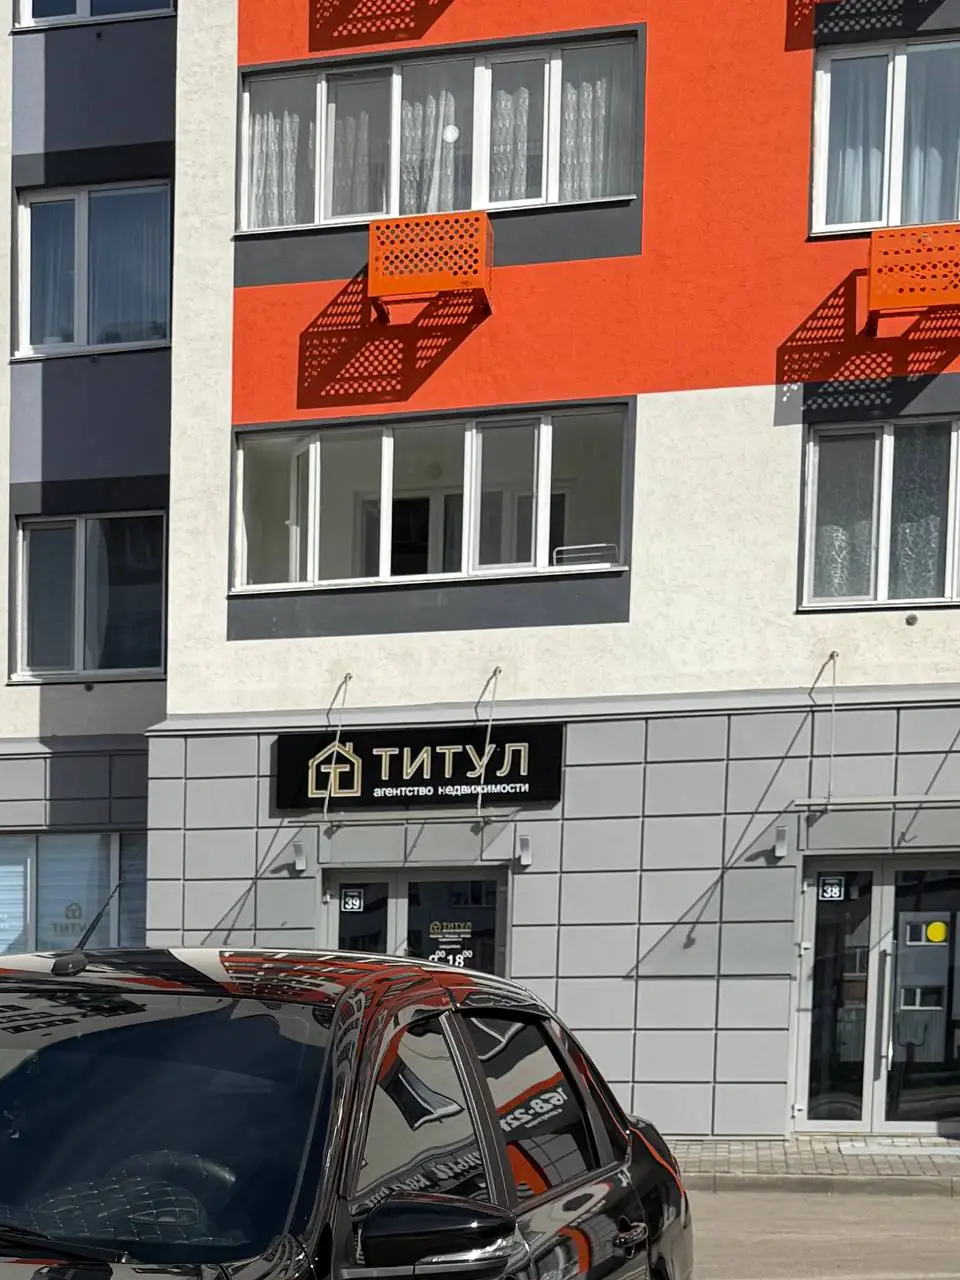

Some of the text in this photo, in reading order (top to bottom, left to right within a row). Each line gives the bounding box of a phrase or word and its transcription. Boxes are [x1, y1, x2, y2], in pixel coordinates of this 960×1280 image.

[372, 742, 530, 781] ТИТУЛ
[373, 782, 530, 798] агентство недвижимости
[823, 885, 840, 898] 38
[345, 896, 360, 909] 39
